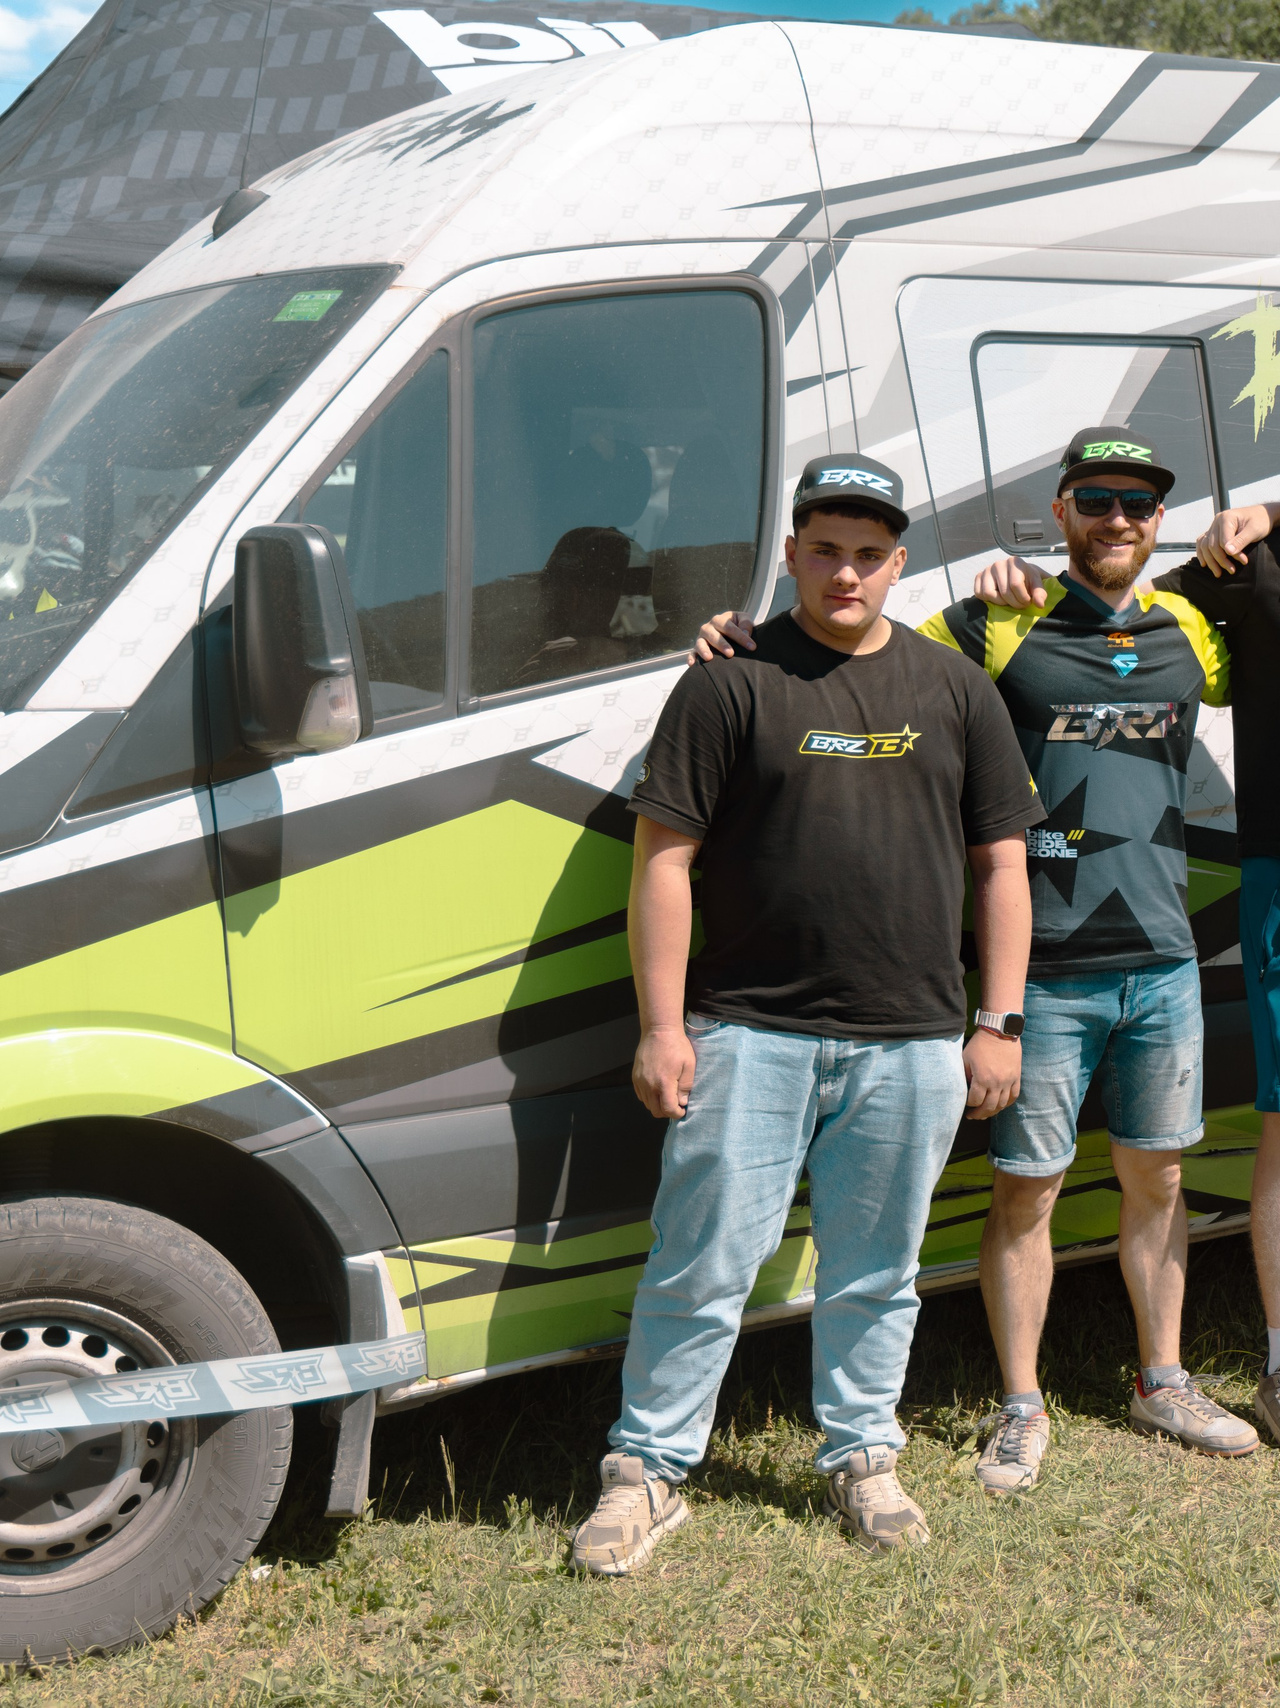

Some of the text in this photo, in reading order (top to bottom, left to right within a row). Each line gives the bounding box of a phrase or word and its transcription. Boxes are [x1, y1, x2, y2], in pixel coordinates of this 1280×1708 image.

[1082, 441, 1152, 464] BRZ
[818, 469, 894, 497] BRZ
[1046, 703, 1188, 751] BRZ
[810, 735, 867, 753] BRZ
[1025, 828, 1066, 840] bike
[1026, 839, 1068, 850] RIDE
[1027, 847, 1078, 859] ZONE
[871, 1451, 888, 1461] FILA
[604, 1460, 619, 1468] FILA
